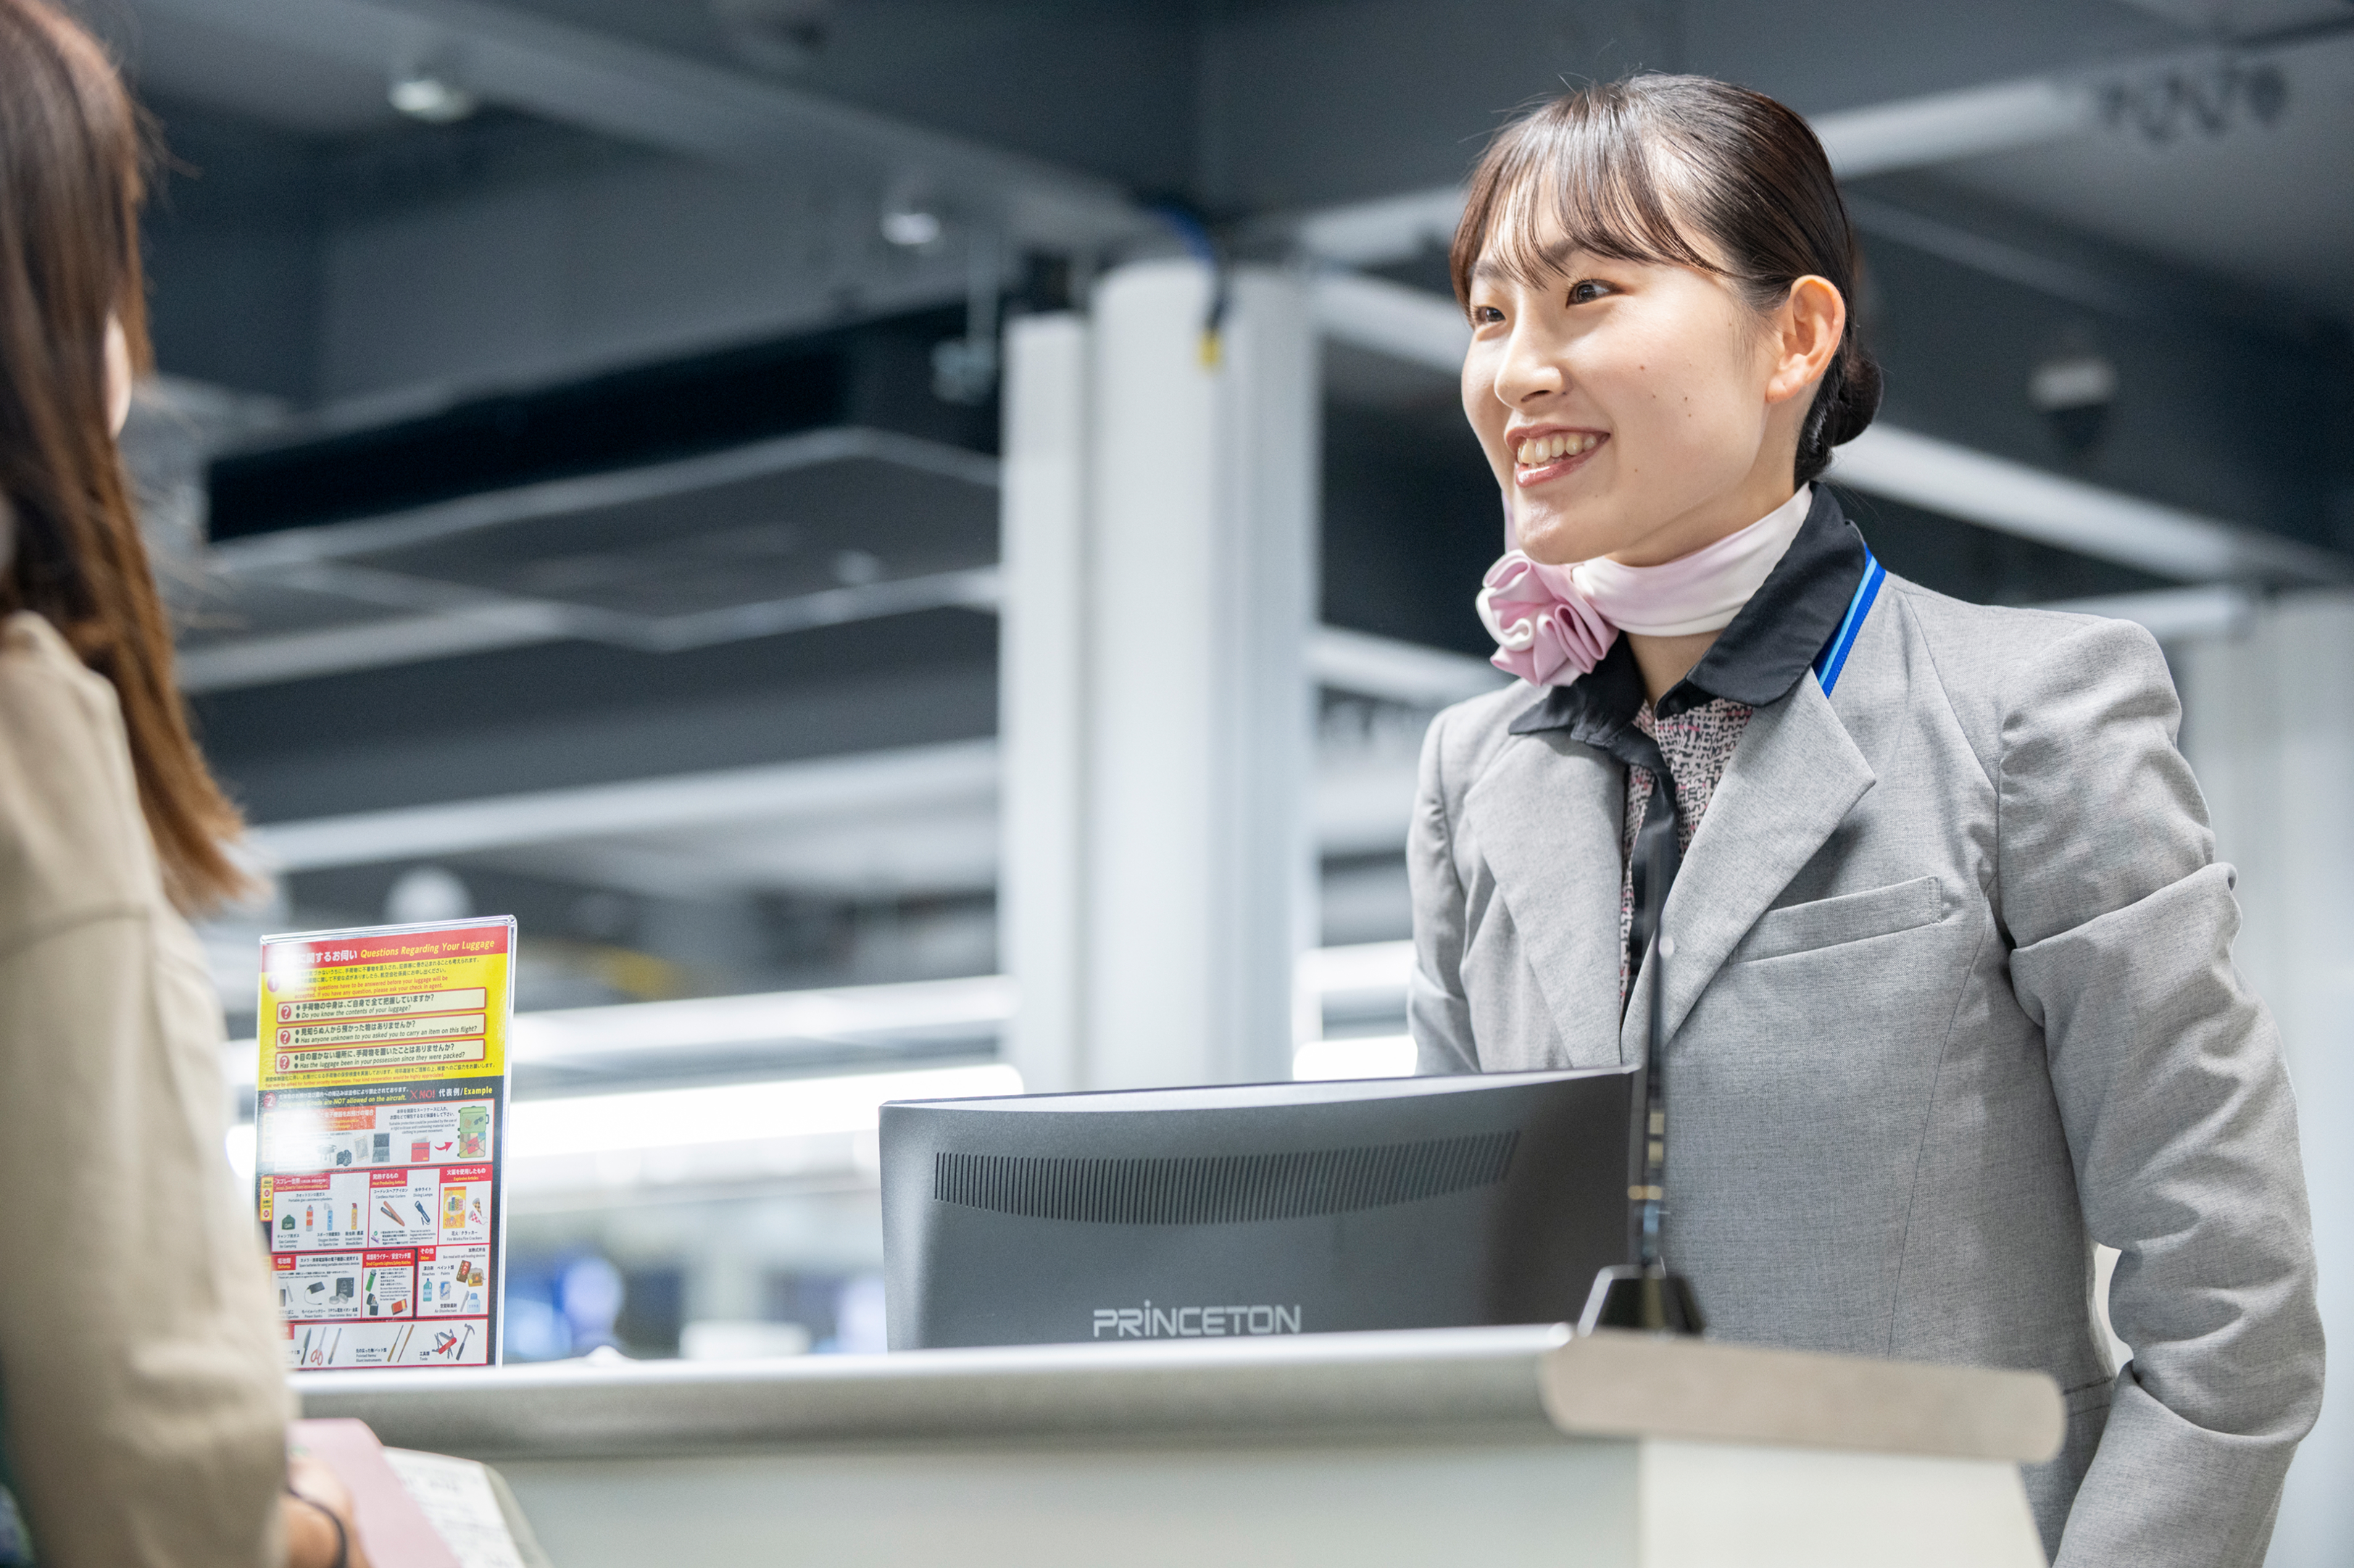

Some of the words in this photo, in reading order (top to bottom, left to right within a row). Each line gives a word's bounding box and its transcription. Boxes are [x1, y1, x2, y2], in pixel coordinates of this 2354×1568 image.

[360, 948, 399, 958] Questions
[401, 944, 439, 956] Regarding
[462, 941, 495, 951] Luggage
[373, 1056, 399, 1065] possession
[443, 1052, 465, 1061] packed?
[419, 1090, 436, 1098] NO!
